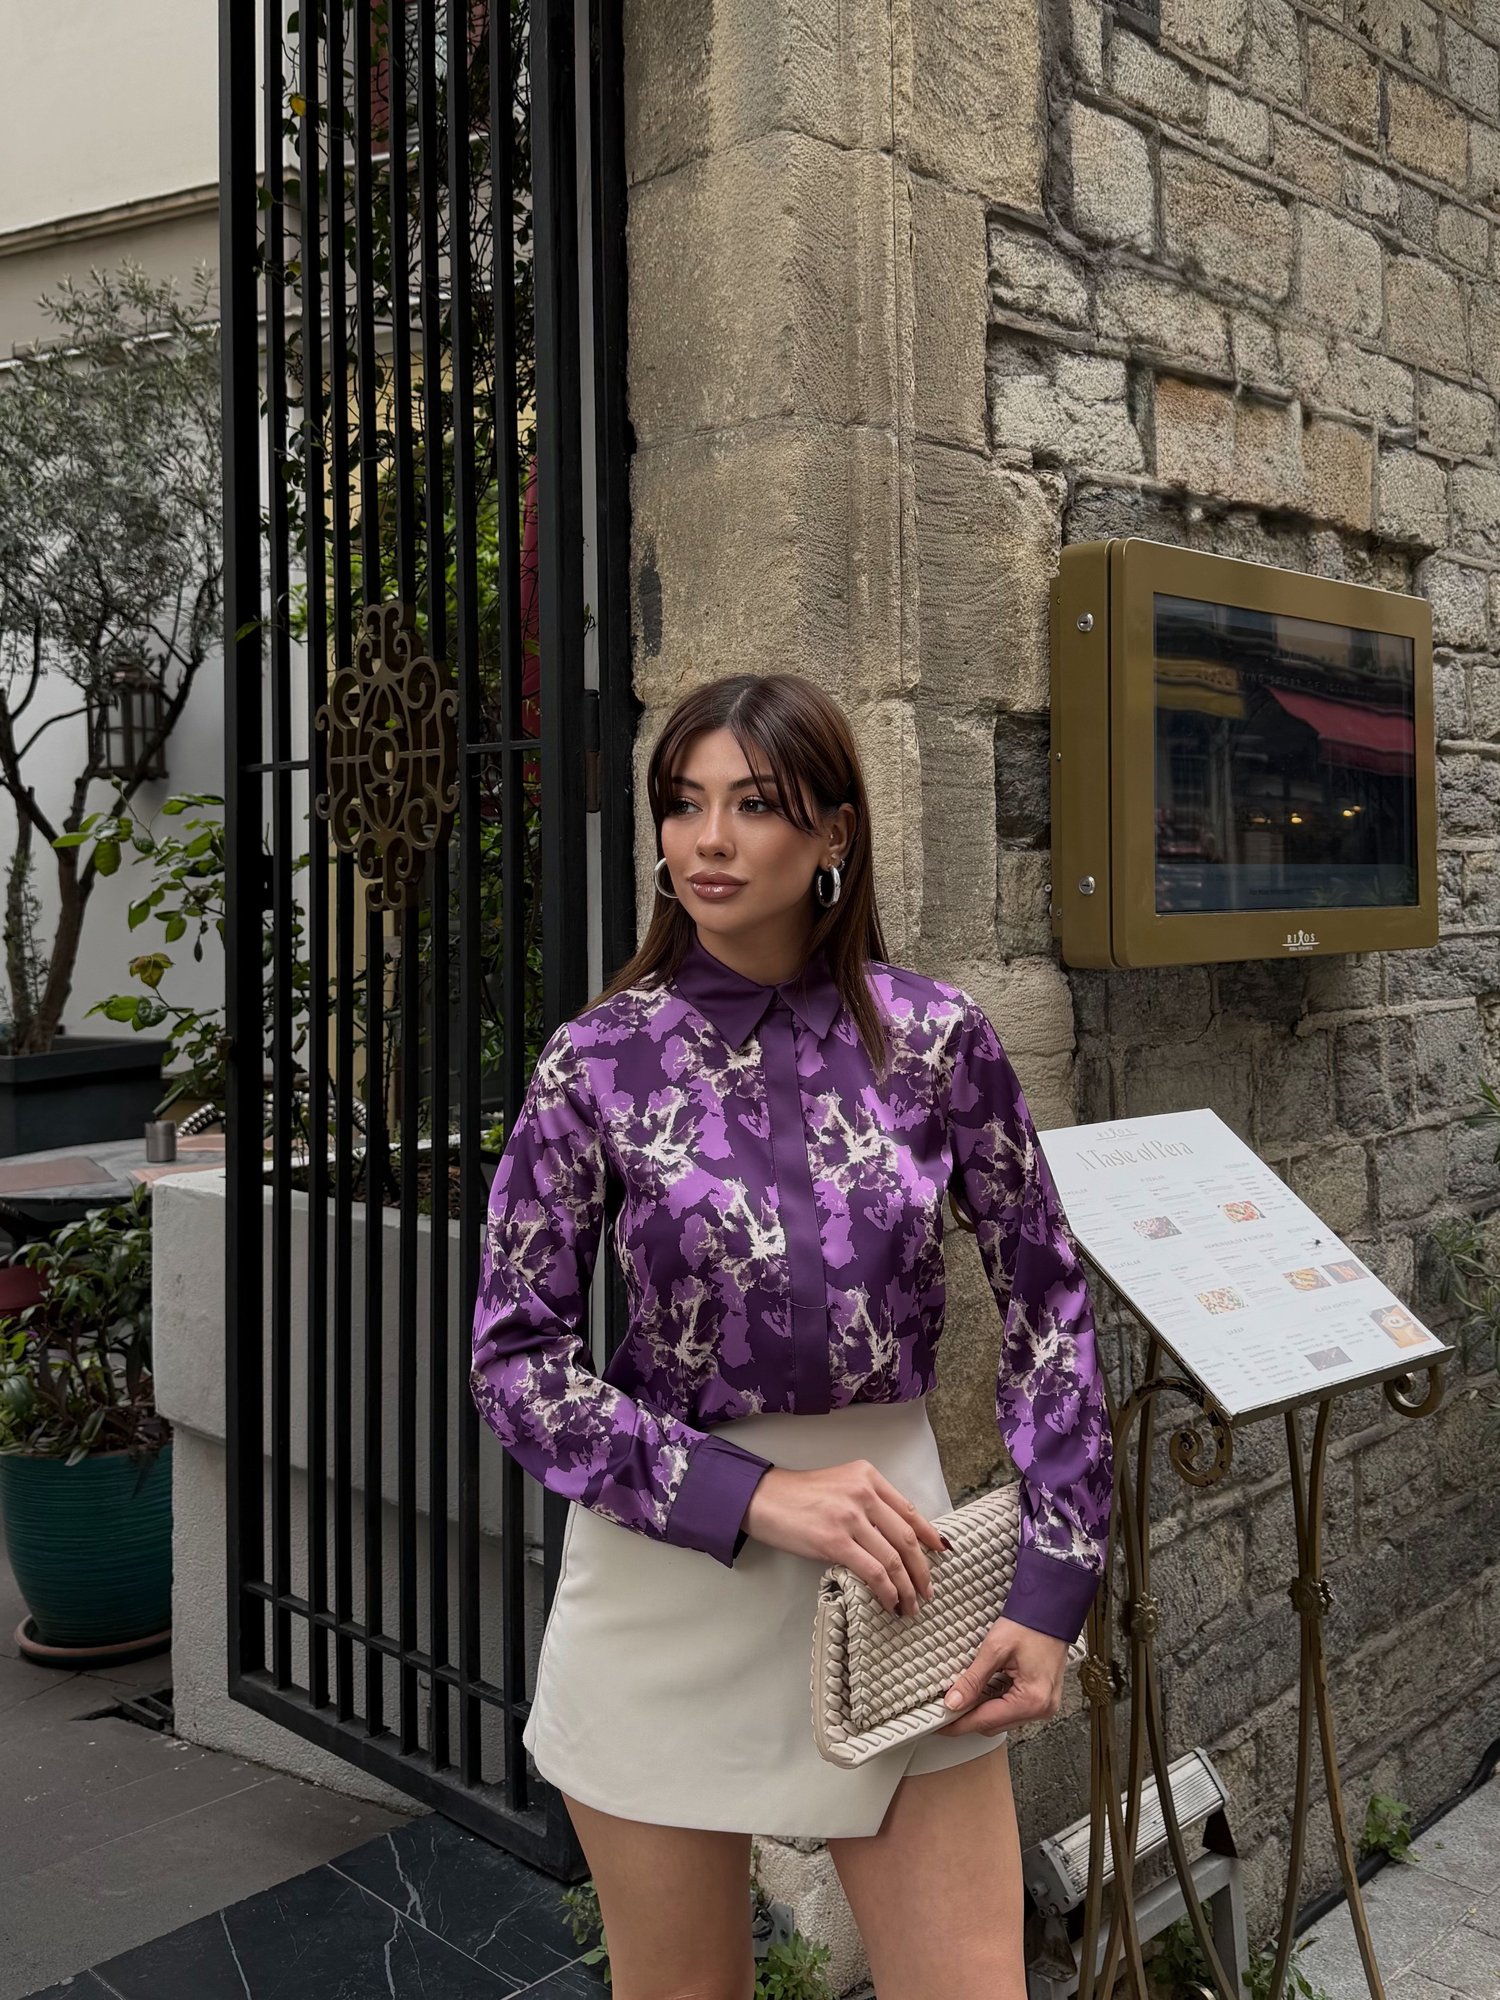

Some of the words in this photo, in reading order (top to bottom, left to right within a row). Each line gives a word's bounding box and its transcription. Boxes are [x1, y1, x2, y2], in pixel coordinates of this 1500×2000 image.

[1285, 930, 1317, 945] RIXOS
[1087, 1149, 1138, 1169] Taste
[1137, 1142, 1157, 1162] of
[1149, 1140, 1195, 1161] Pera
